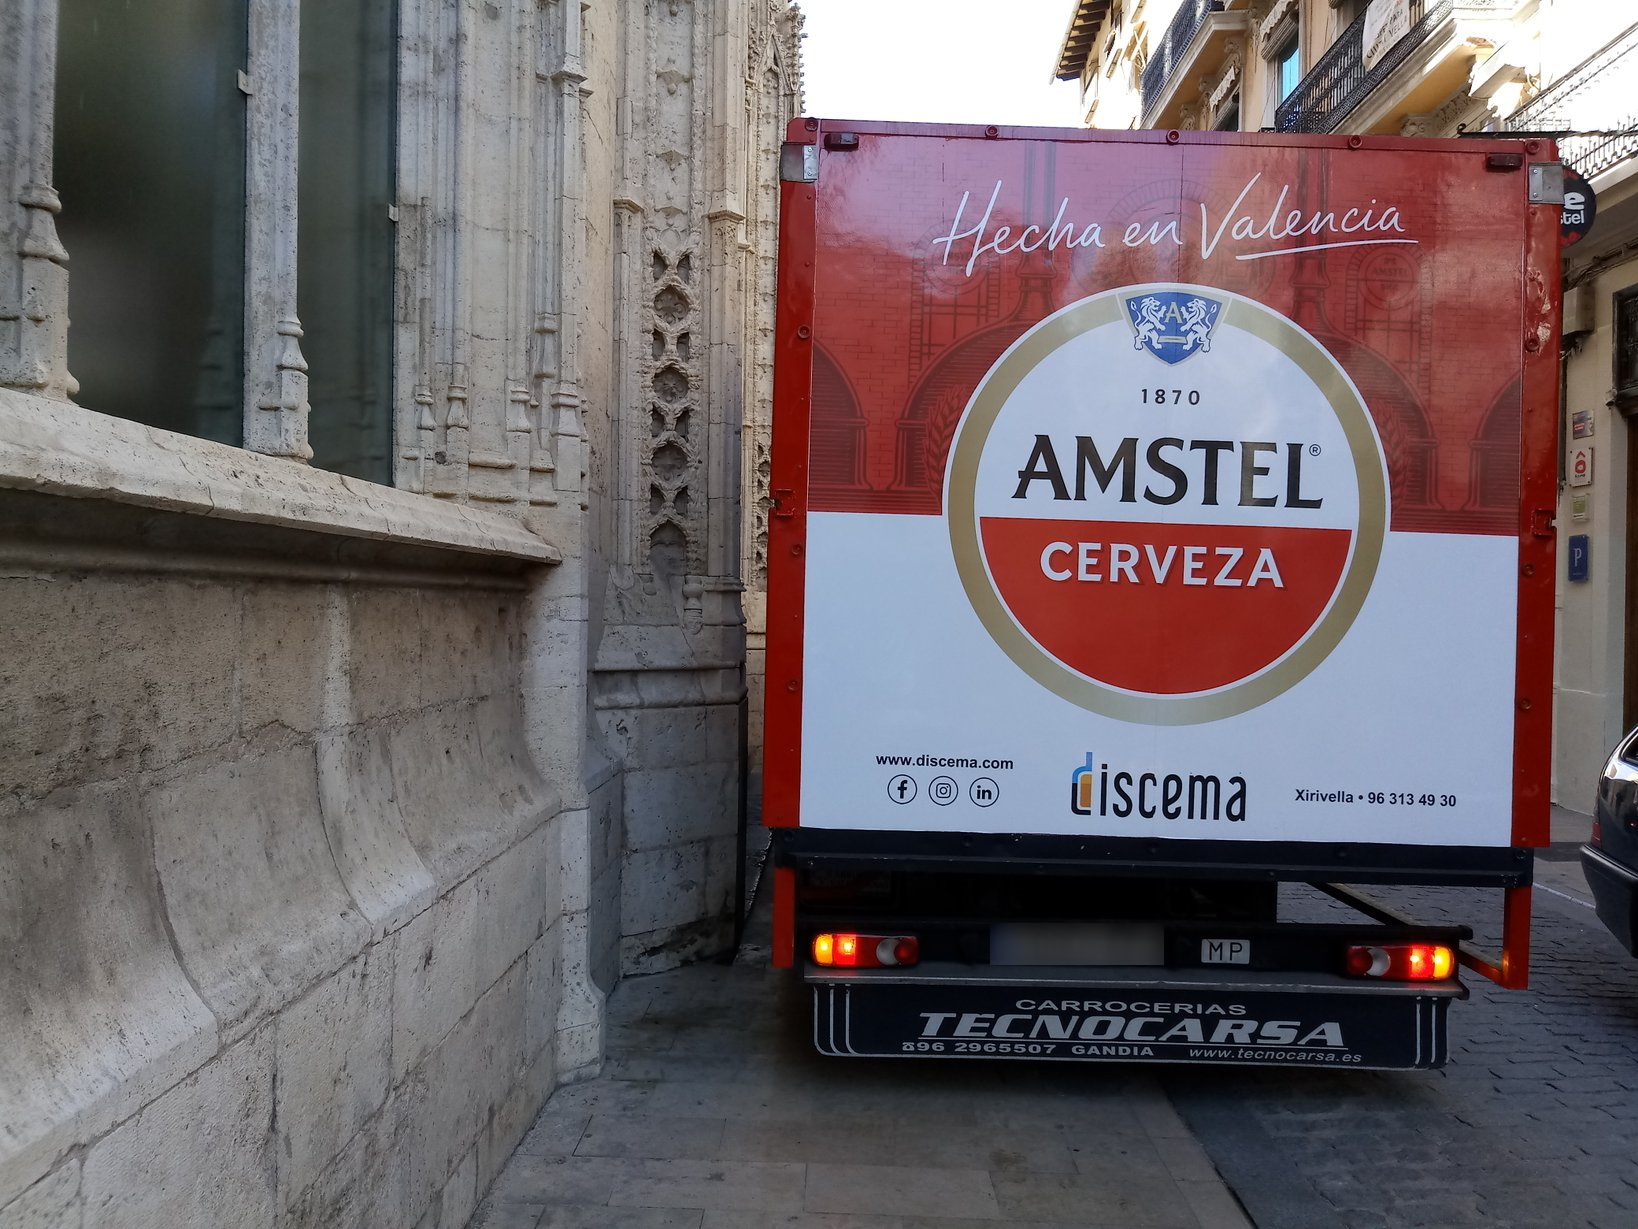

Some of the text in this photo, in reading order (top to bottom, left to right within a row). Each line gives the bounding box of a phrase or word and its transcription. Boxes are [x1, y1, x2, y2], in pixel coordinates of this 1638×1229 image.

[933, 172, 1406, 277] Hecha en Valencia
[1141, 388, 1200, 406] 1870
[1040, 541, 1284, 588] CERVEZA
[875, 754, 1014, 770] www.discema.com
[1071, 751, 1247, 823] discema
[1294, 788, 1458, 808] Xirivella 96 313 49 30
[1207, 941, 1244, 963] MP
[1014, 999, 1247, 1016] CARROCERIAS
[918, 1011, 1344, 1048] TECNOCARSA
[953, 1042, 1057, 1055] 2965507
[1071, 1044, 1155, 1057] GANDIA
[1188, 1048, 1363, 1064] www.tecnocarsa.es
